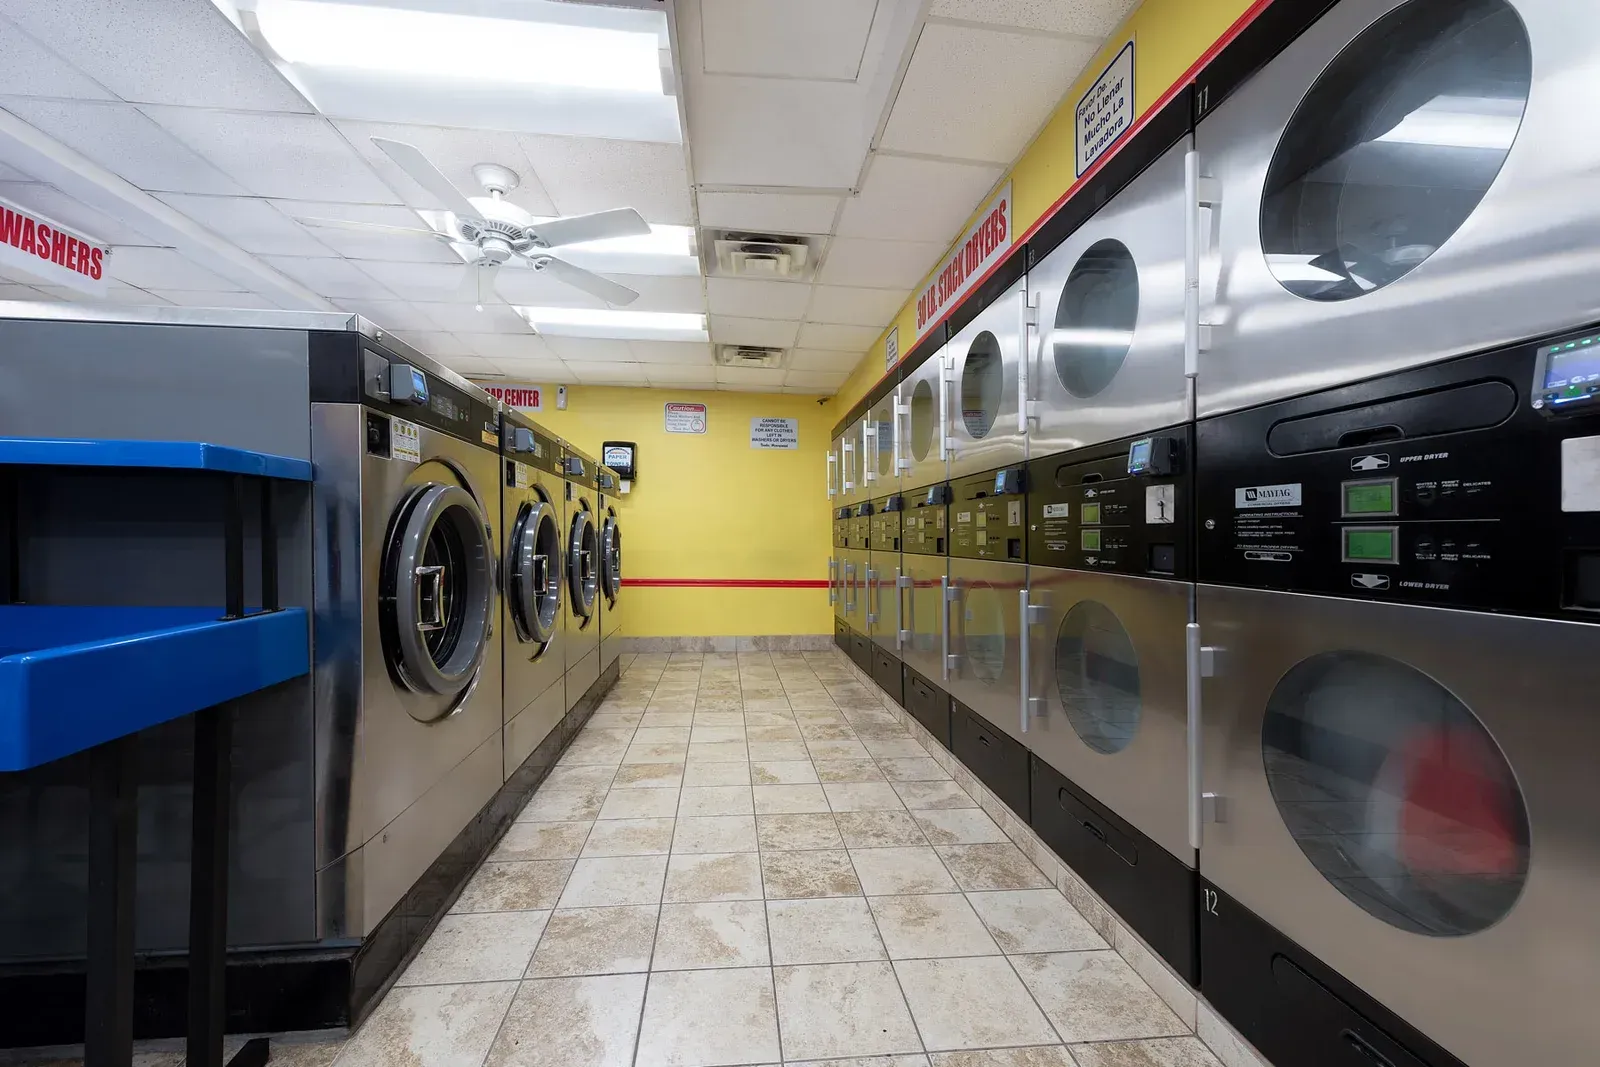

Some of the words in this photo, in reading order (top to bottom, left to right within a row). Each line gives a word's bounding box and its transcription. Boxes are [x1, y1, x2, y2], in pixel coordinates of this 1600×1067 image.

[1078, 95, 1096, 120] Favor
[1084, 112, 1095, 129] No
[1097, 77, 1124, 114] Llenar
[1197, 85, 1209, 115] 11
[1084, 111, 1111, 146] Mucho
[1113, 97, 1124, 113] La
[1085, 116, 1123, 162] Lavadora
[0, 206, 103, 280] WASHERS
[917, 298, 927, 330] 30
[927, 284, 938, 319] LB.
[938, 248, 965, 307] STACK
[965, 199, 1007, 279] DRYERS
[504, 388, 540, 407] CENTER
[1400, 455, 1422, 463] UPPER
[1424, 452, 1449, 460] DRYER
[1258, 489, 1290, 498] MAYTAG
[1399, 580, 1423, 588] LOWER
[1204, 888, 1219, 916] 12
